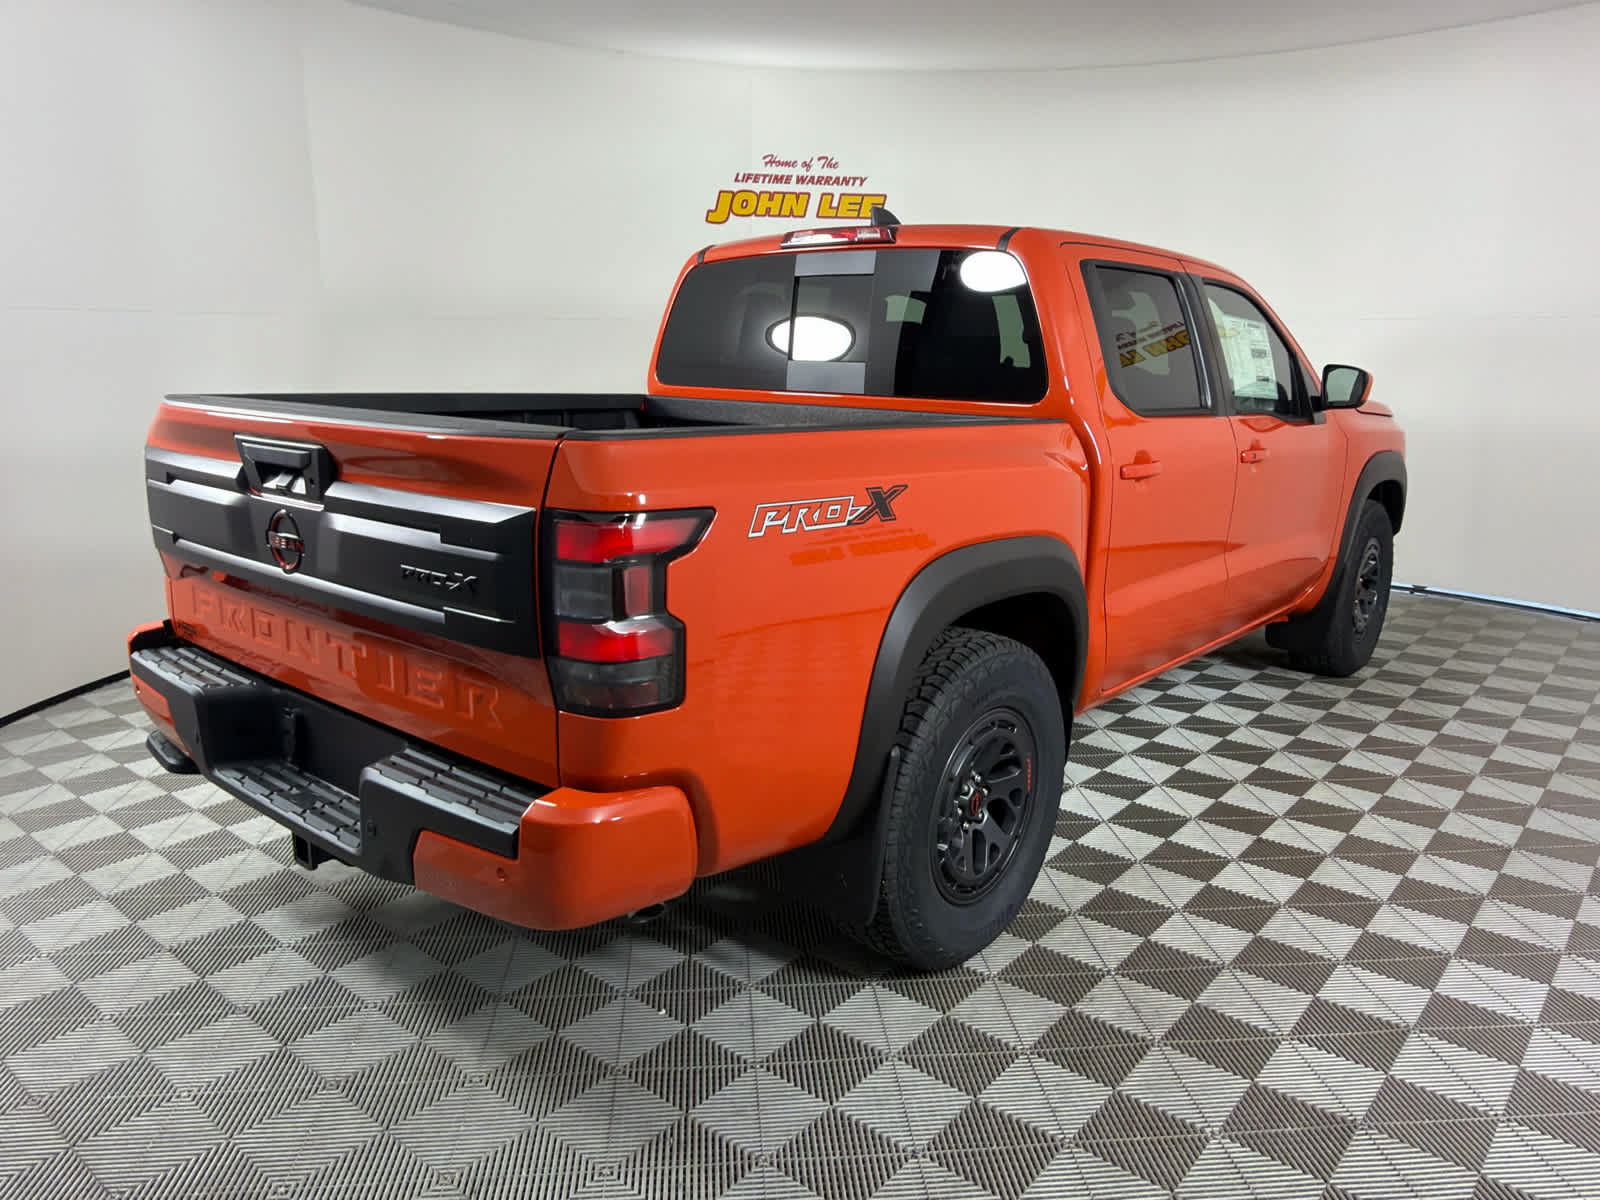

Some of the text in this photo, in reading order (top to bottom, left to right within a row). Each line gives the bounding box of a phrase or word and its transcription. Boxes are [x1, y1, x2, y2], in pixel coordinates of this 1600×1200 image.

[734, 172, 868, 187] LIFETIME WARRANTY
[762, 153, 840, 172] Home of The
[705, 189, 810, 224] JOHN
[748, 484, 908, 538] PRO-X
[191, 583, 503, 732] FRONTIER
